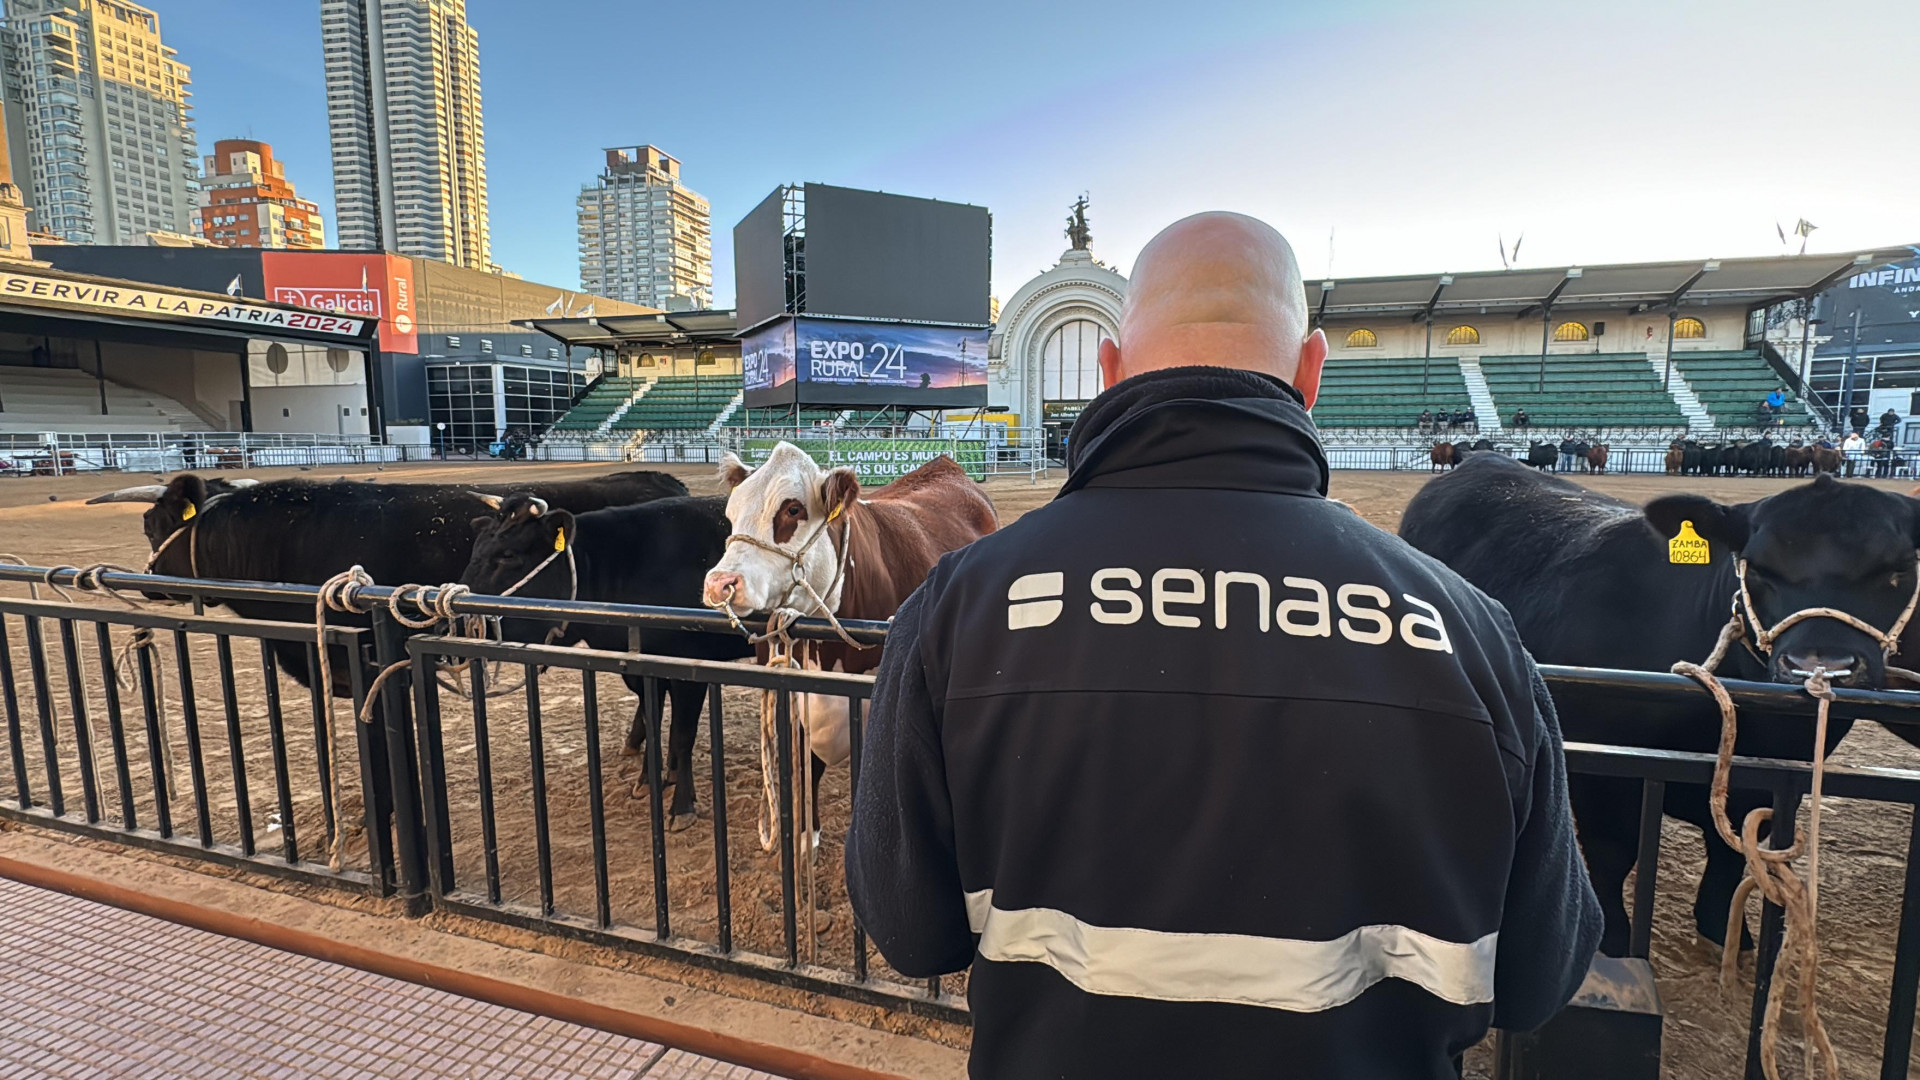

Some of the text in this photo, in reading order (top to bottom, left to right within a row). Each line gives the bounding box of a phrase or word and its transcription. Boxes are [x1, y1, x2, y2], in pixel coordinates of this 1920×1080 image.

[310, 293, 374, 312] Galicia
[393, 276, 409, 312] Rural
[5, 278, 354, 334] SERVIR A LA PATRIA 2024
[811, 340, 865, 360] EXPO
[811, 360, 870, 378] RURAL
[870, 343, 908, 379] 24
[829, 450, 844, 462] EL
[847, 451, 891, 462] CAMPO
[895, 451, 909, 461] ES
[873, 463, 899, 475] QUE
[1672, 539, 1708, 549] ZAMBA
[1670, 550, 1707, 564] 10864
[1090, 567, 1454, 655] senasa
